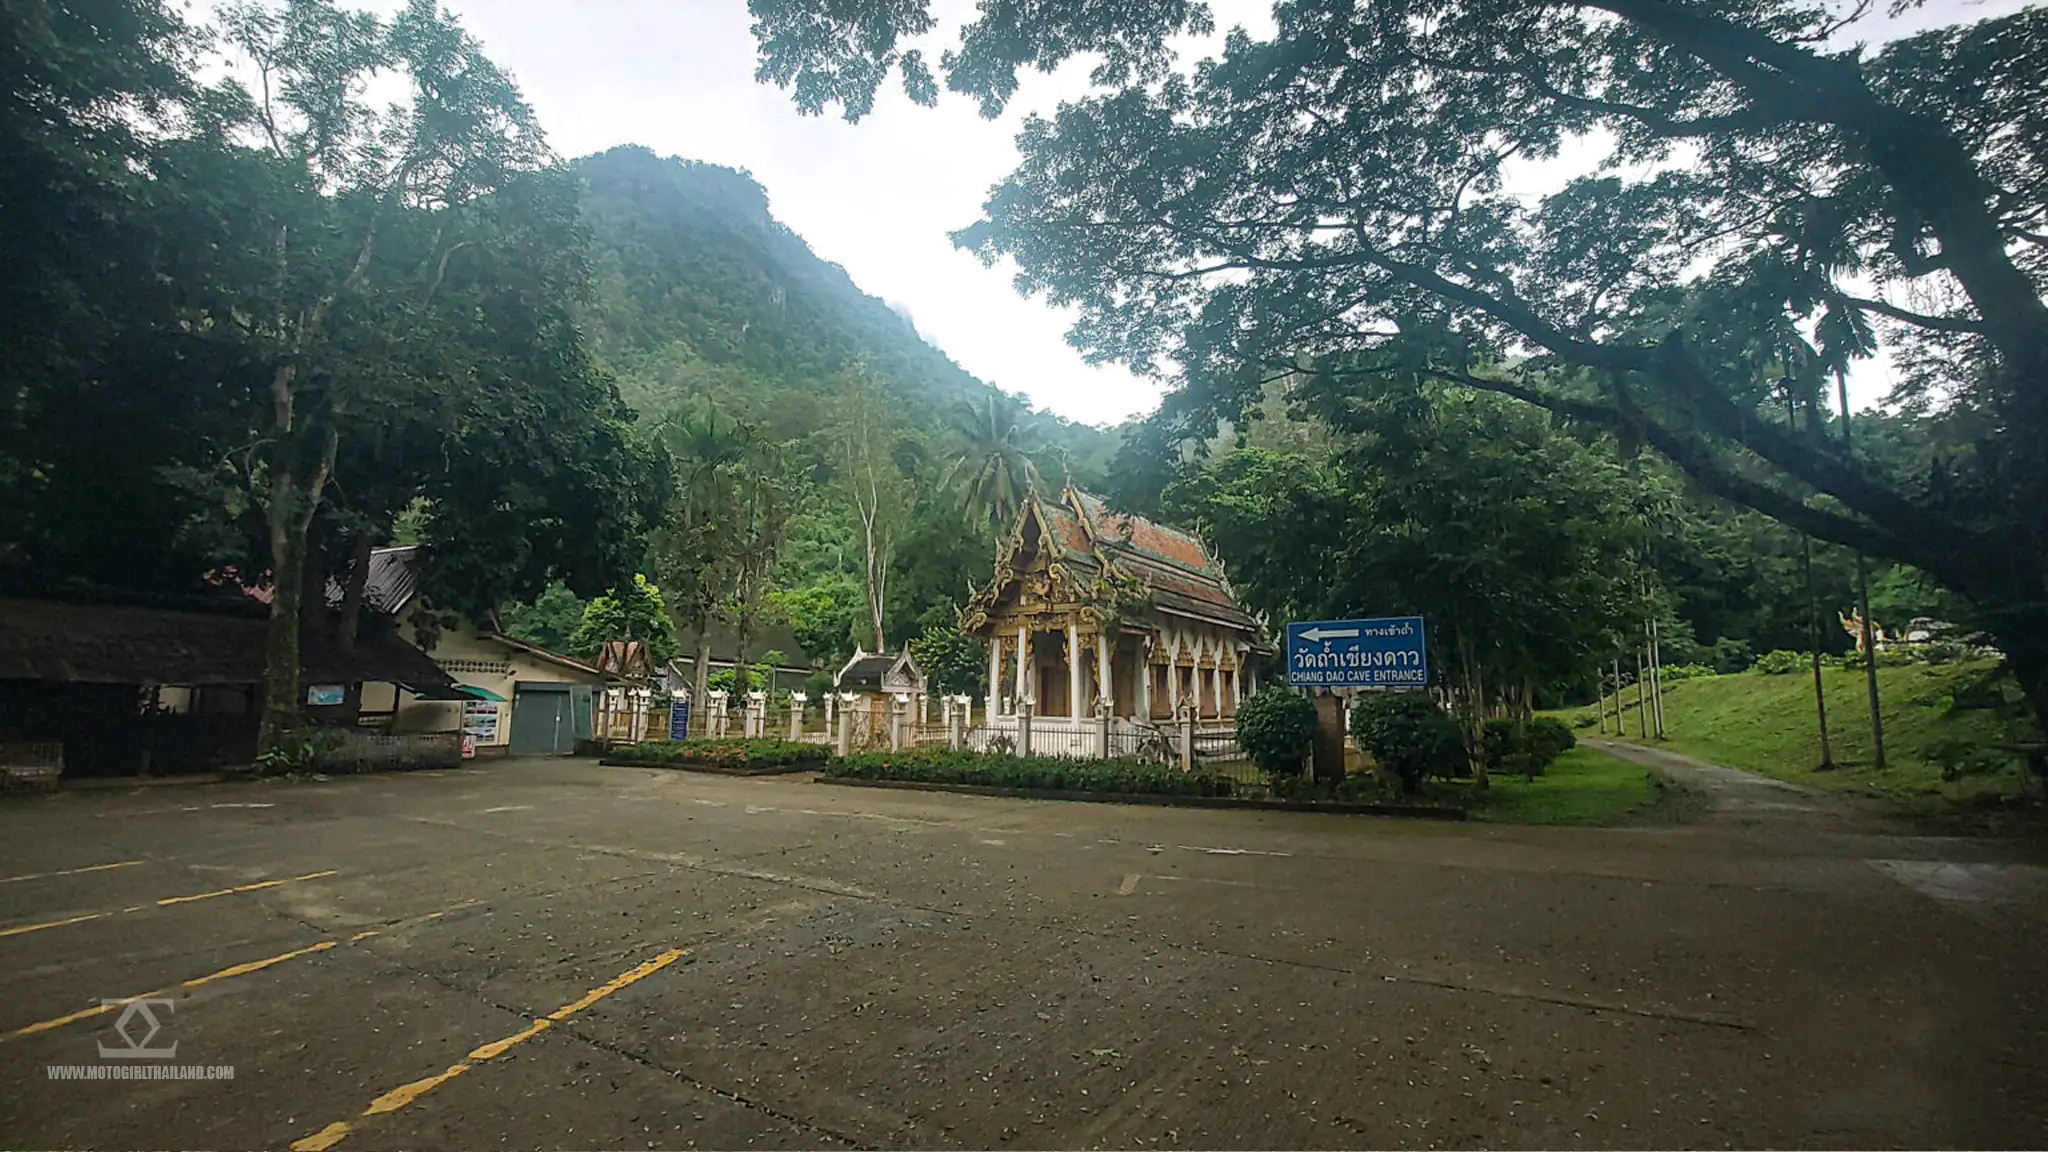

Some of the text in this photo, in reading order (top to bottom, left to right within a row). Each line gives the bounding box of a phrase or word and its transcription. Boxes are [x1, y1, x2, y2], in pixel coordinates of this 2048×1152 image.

[1365, 622, 1414, 637] ทางเข้าถ้ำ
[1294, 641, 1420, 668] วัดถ้ำเชียงดาว
[1291, 669, 1424, 683] CHIANG DAO CAVE ENTRANCE
